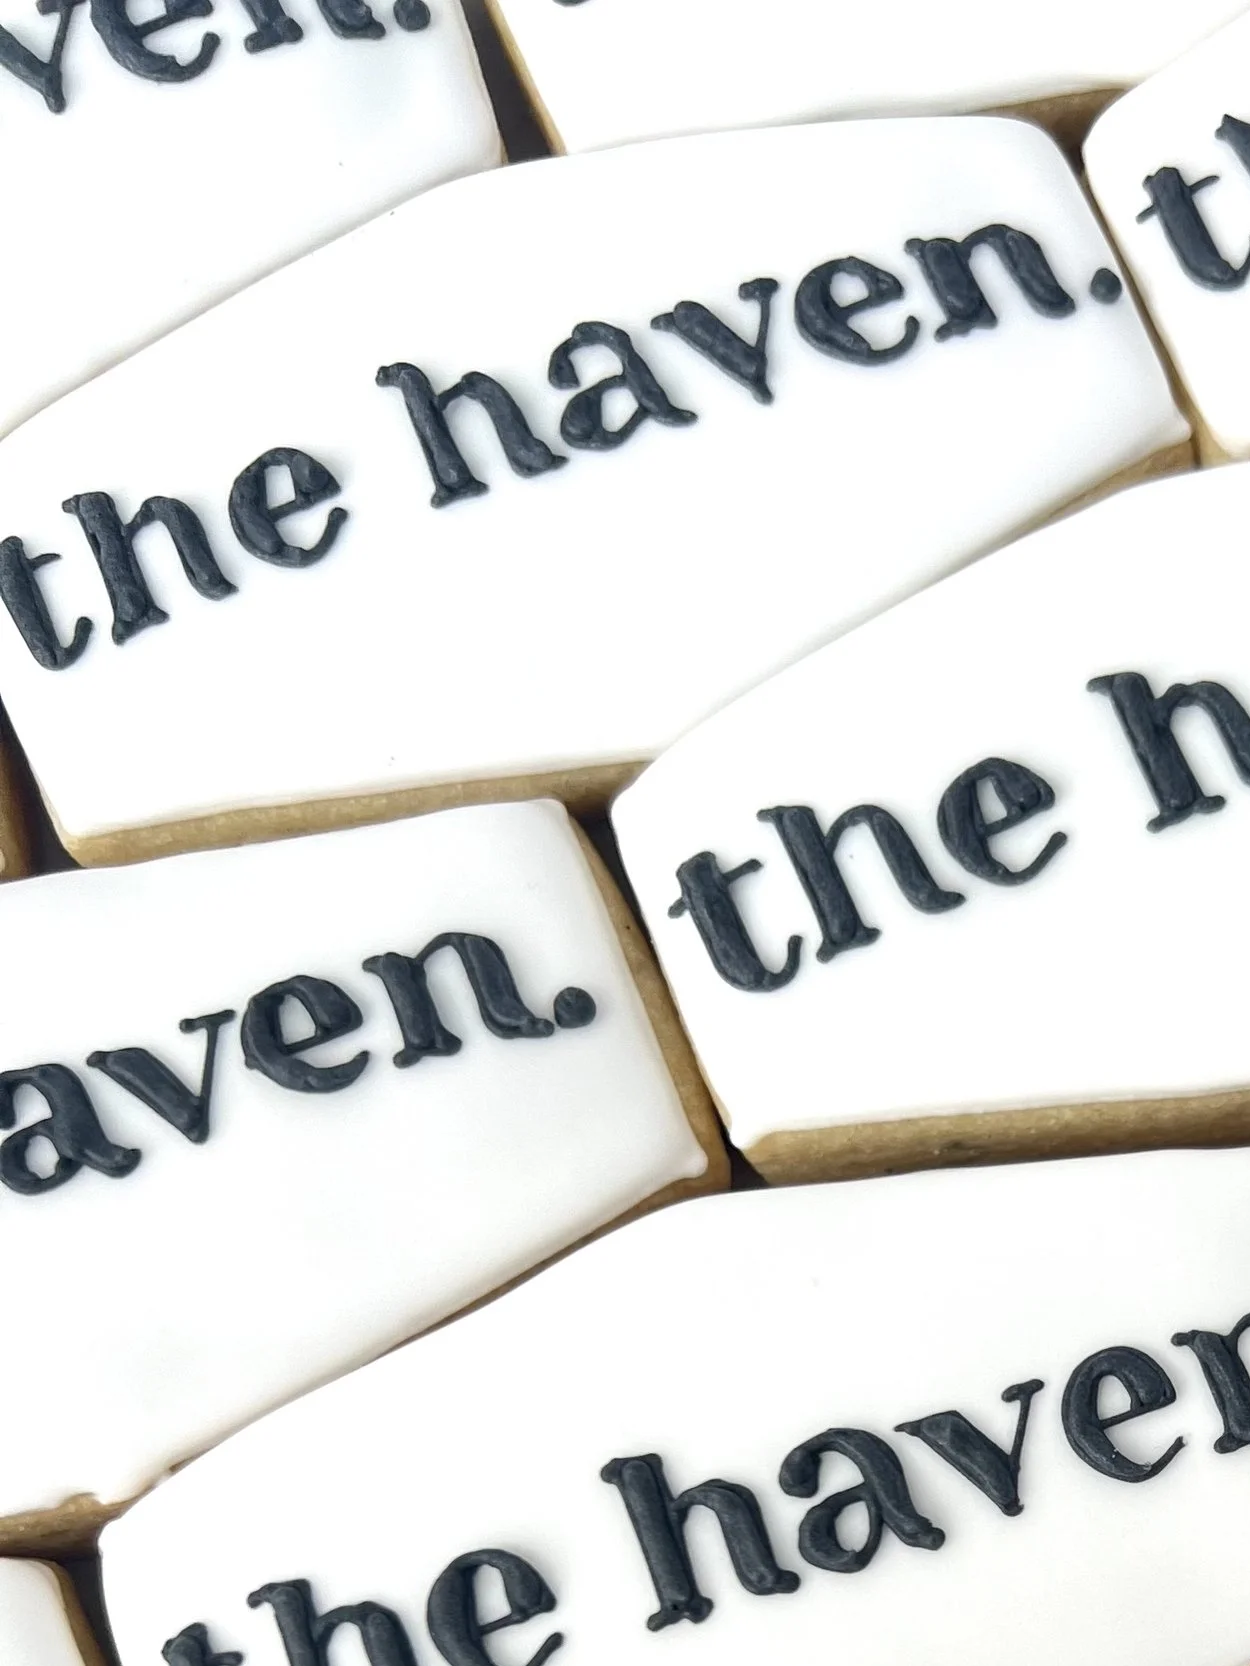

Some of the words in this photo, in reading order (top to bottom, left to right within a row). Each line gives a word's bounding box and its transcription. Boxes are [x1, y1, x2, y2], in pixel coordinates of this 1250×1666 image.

[0, 445, 350, 671] the
[373, 221, 1125, 509] haven.
[666, 755, 1070, 994] the
